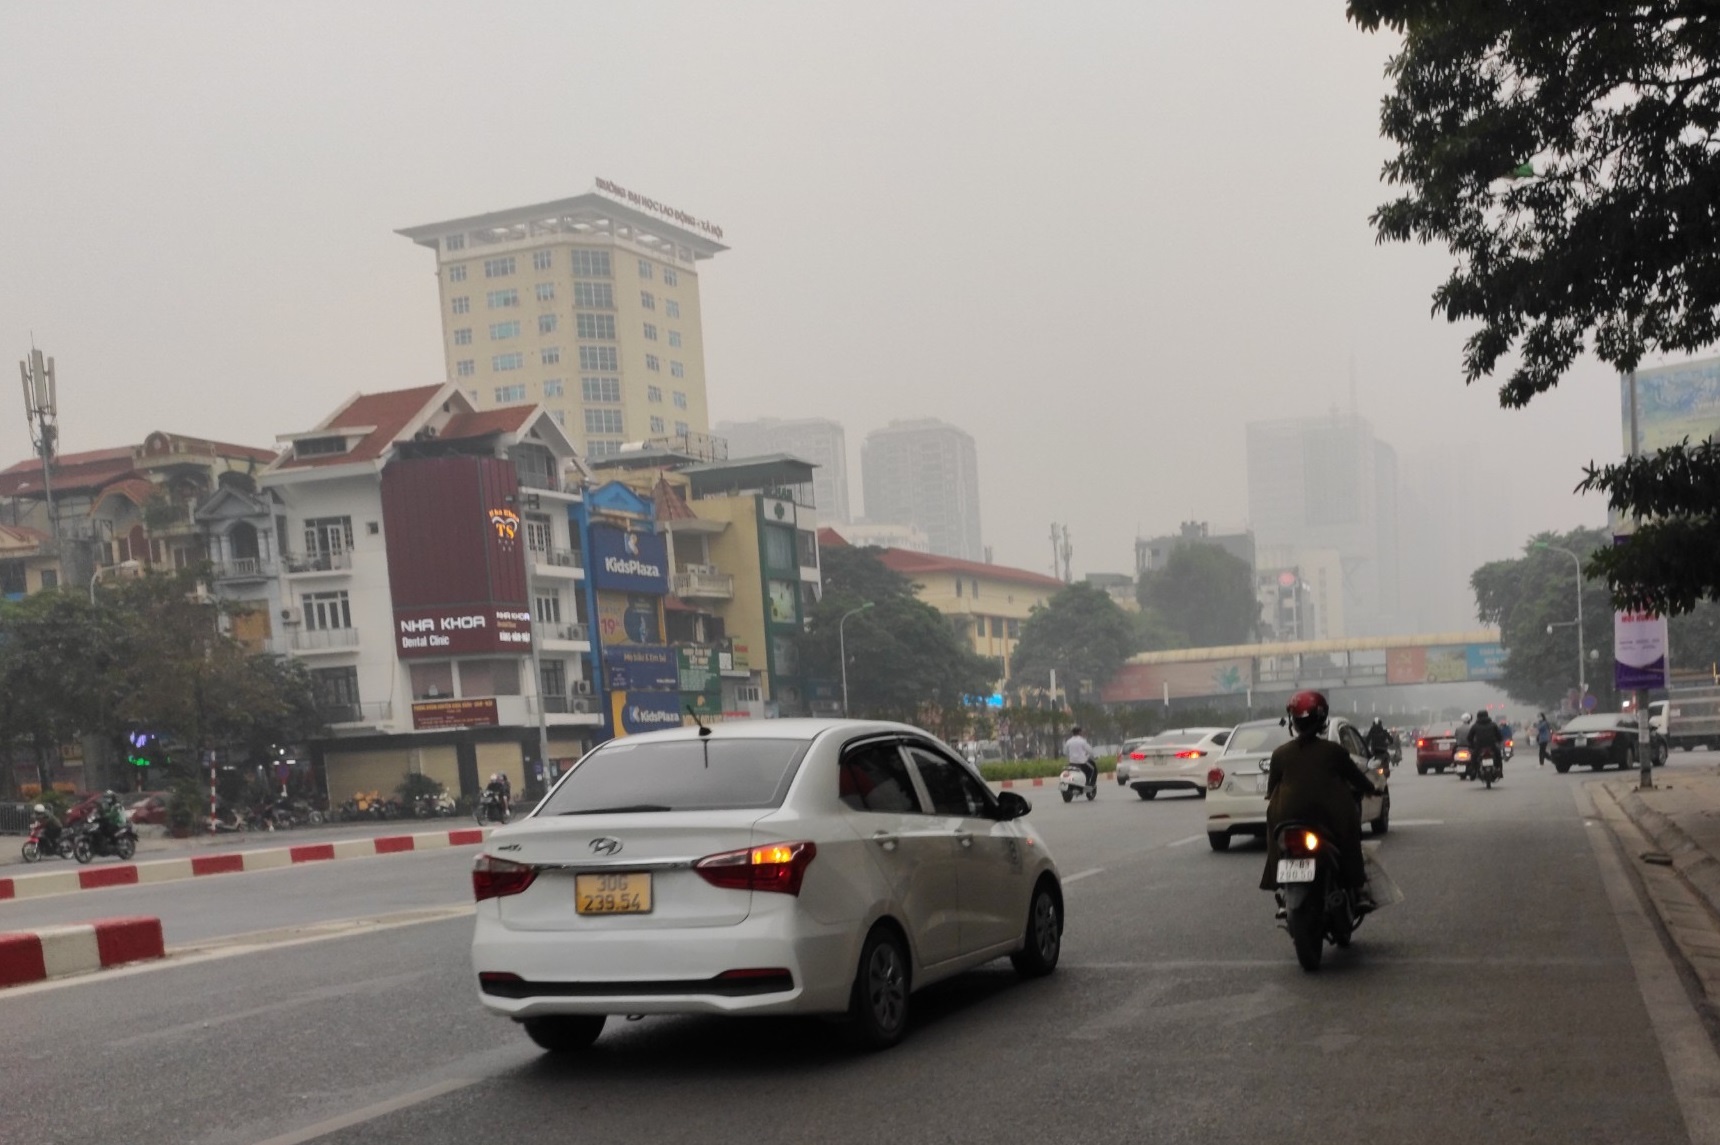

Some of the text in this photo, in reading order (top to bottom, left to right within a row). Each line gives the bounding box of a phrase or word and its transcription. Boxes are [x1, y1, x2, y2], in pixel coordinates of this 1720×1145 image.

[659, 203, 674, 217] LAO
[496, 523, 514, 539] TS
[604, 556, 660, 577] KidsPlaza
[400, 618, 435, 633] NHA
[440, 615, 486, 630] KHOA
[401, 635, 450, 648] Dental Clinic
[640, 710, 680, 722] KidsPlaza
[597, 875, 628, 891] 30G
[584, 893, 641, 911] 239.54
